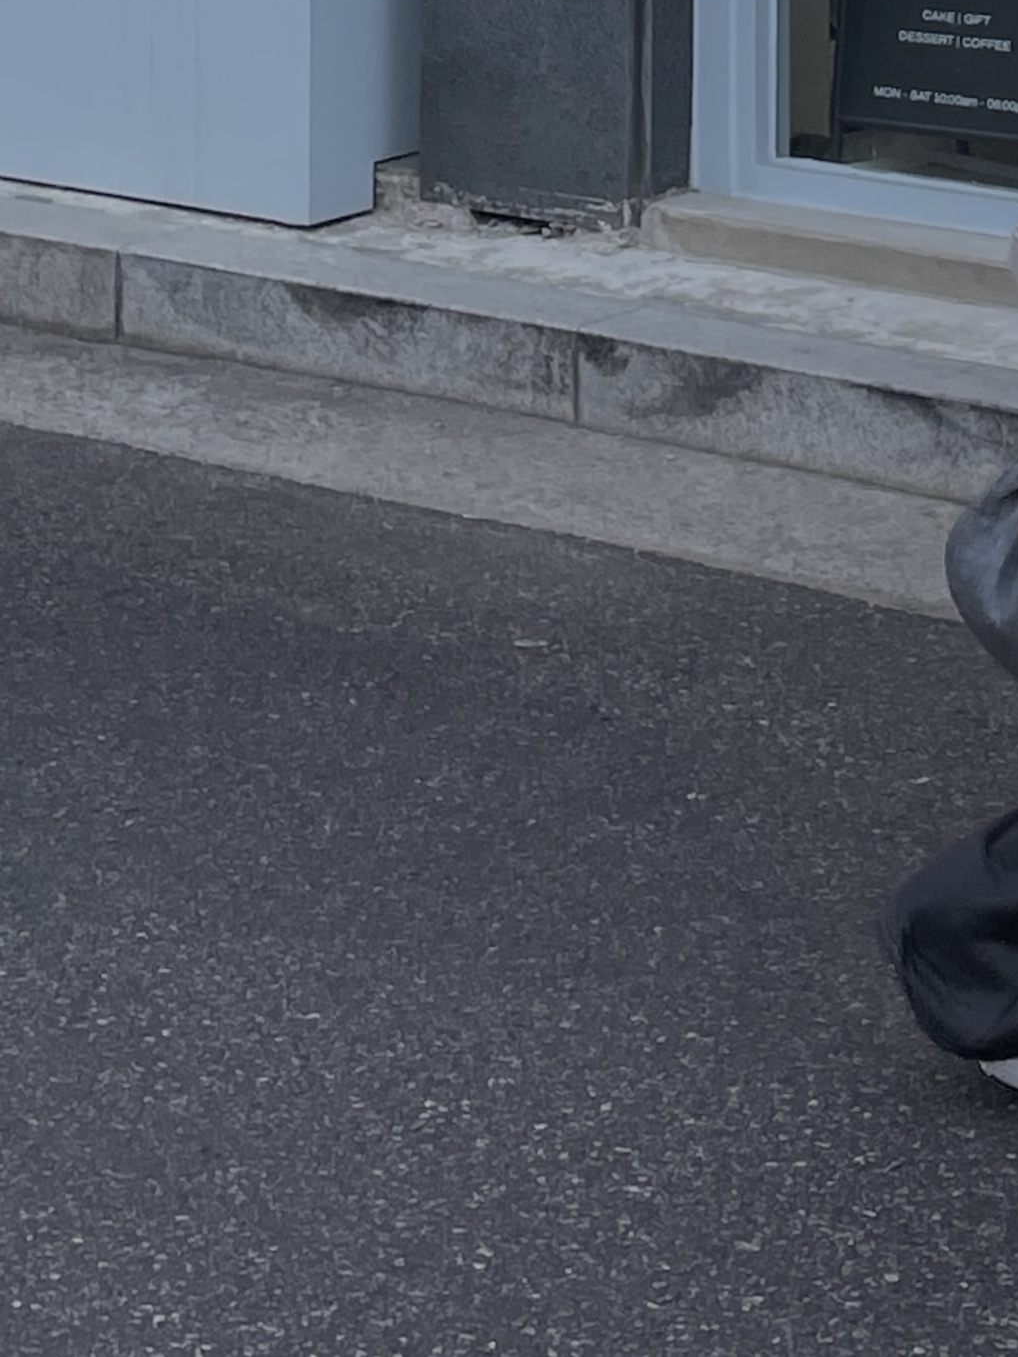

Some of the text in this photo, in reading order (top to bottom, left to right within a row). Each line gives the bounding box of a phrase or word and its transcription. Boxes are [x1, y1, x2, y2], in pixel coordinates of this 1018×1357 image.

[922, 8, 956, 24] CAKE
[963, 13, 992, 26] GIFT
[898, 30, 954, 46] DESSERT
[962, 36, 1012, 52] COFFEE
[873, 85, 901, 98] MON
[909, 88, 932, 102] SAT
